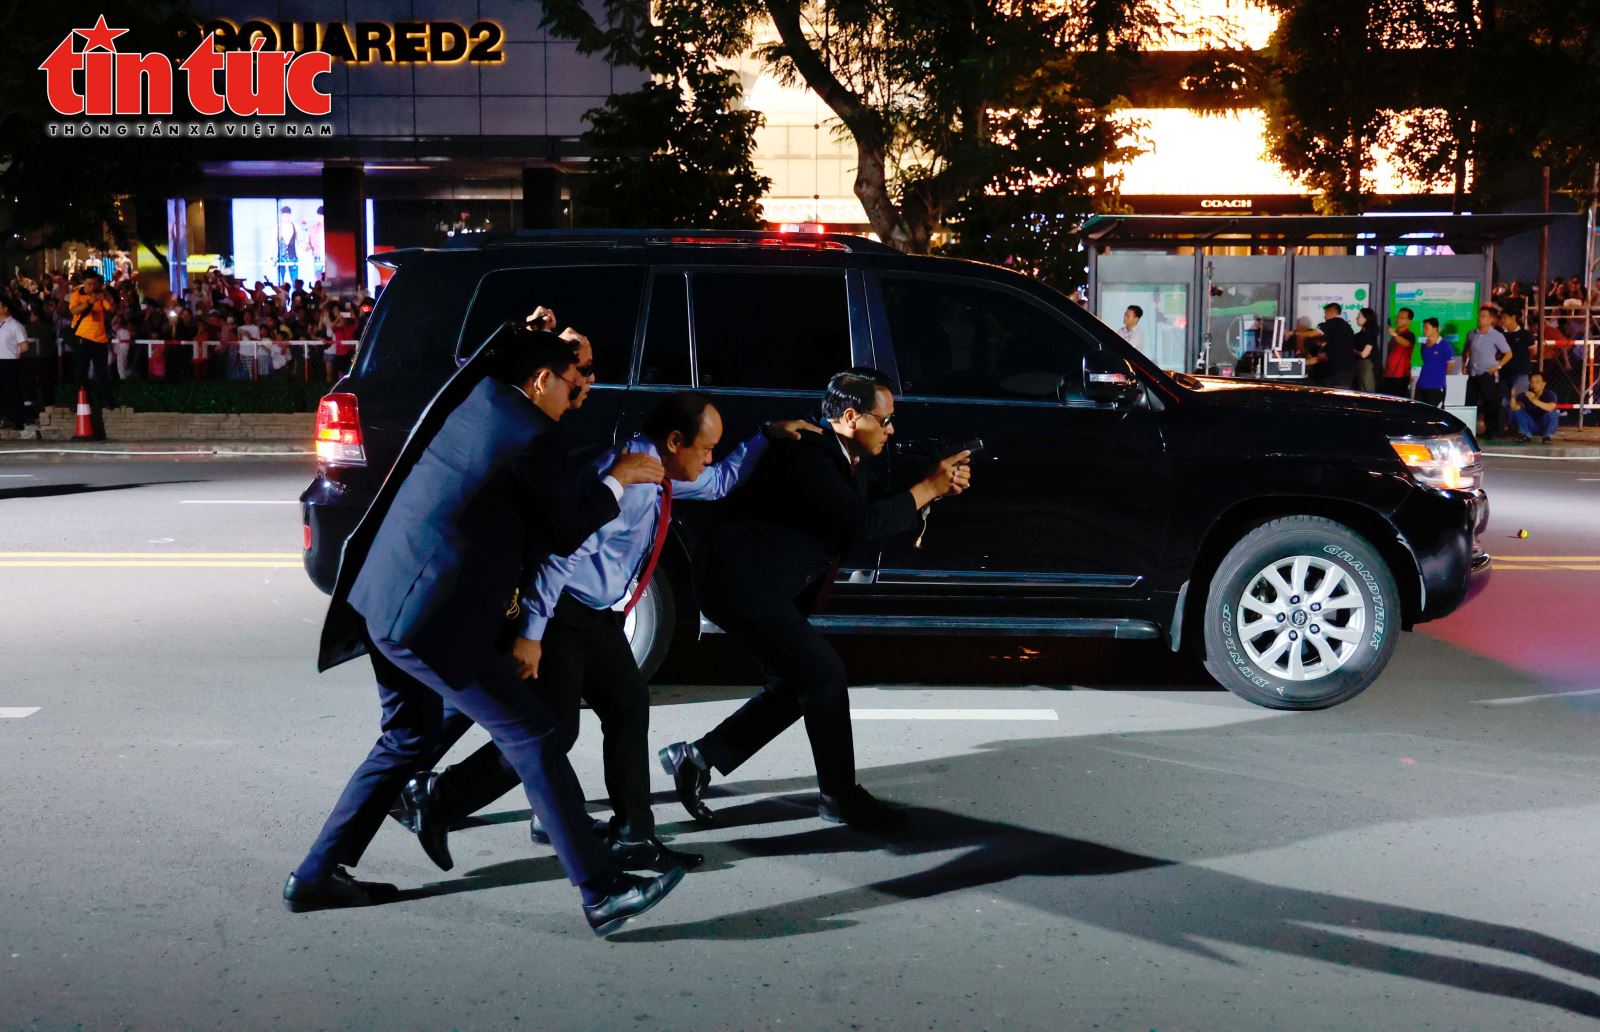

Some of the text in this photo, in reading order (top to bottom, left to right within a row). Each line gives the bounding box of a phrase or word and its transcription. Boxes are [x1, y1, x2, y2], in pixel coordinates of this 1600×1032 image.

[1201, 199, 1252, 208] COACH
[1323, 544, 1385, 650] GRANDTREK
[1221, 605, 1270, 688] DUNLOP
